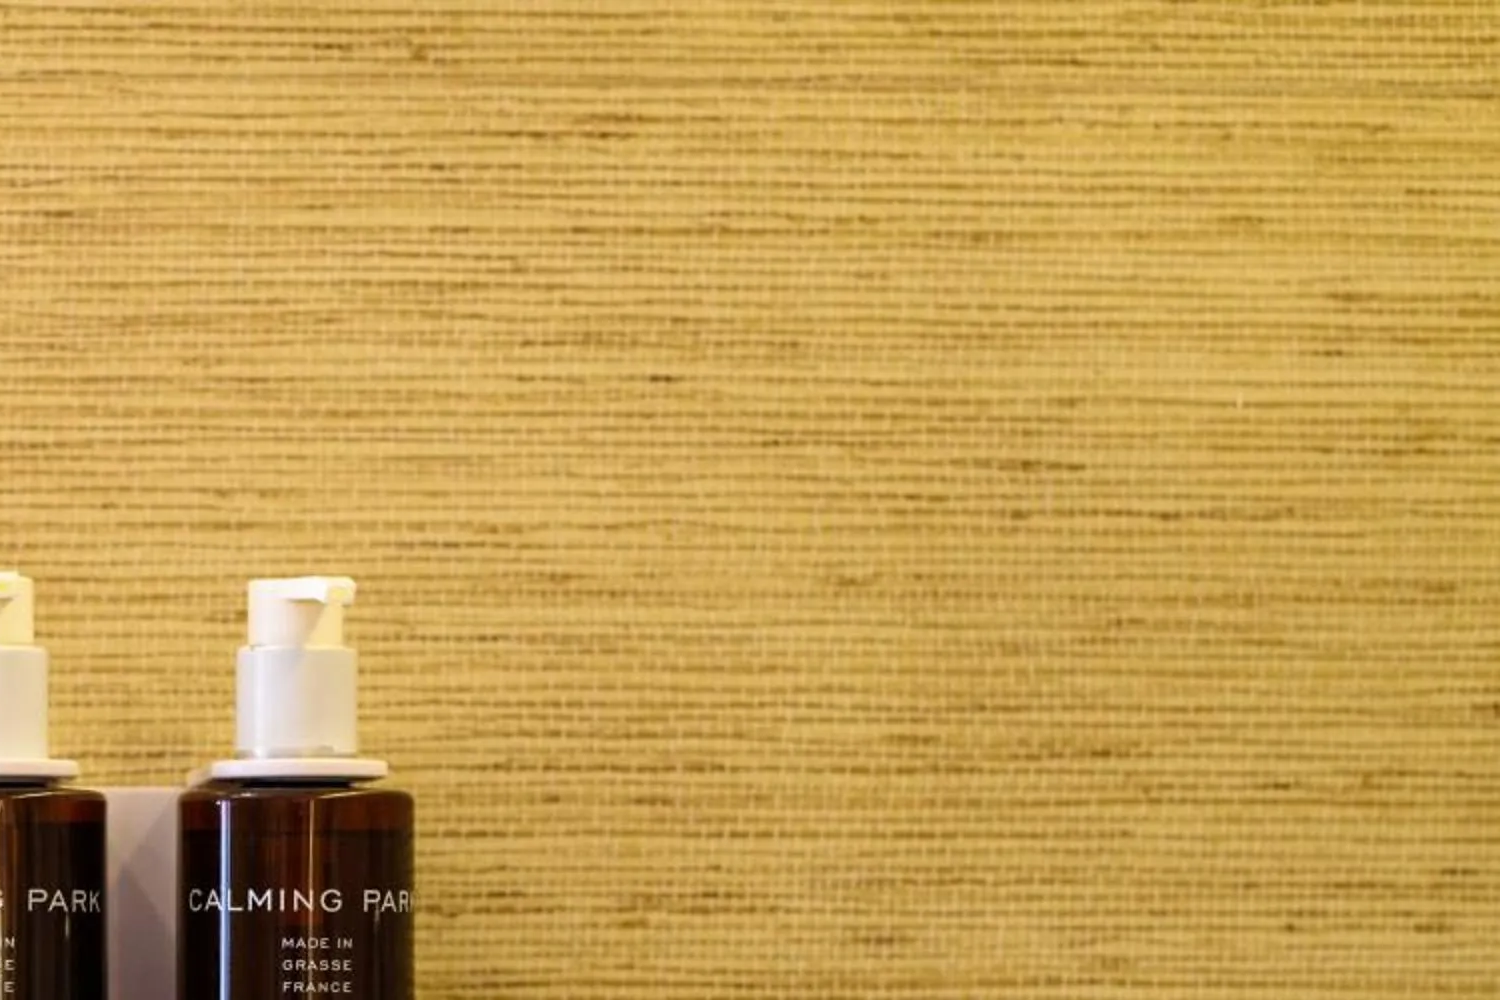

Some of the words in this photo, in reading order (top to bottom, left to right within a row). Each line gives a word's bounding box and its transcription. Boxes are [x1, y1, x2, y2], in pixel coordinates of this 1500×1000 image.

[27, 888, 101, 913] PARK
[188, 888, 343, 913] CALMING
[281, 937, 329, 949] MADE
[337, 937, 354, 949] IN
[282, 959, 353, 971] GRASSE
[282, 981, 353, 993] FRANCE
